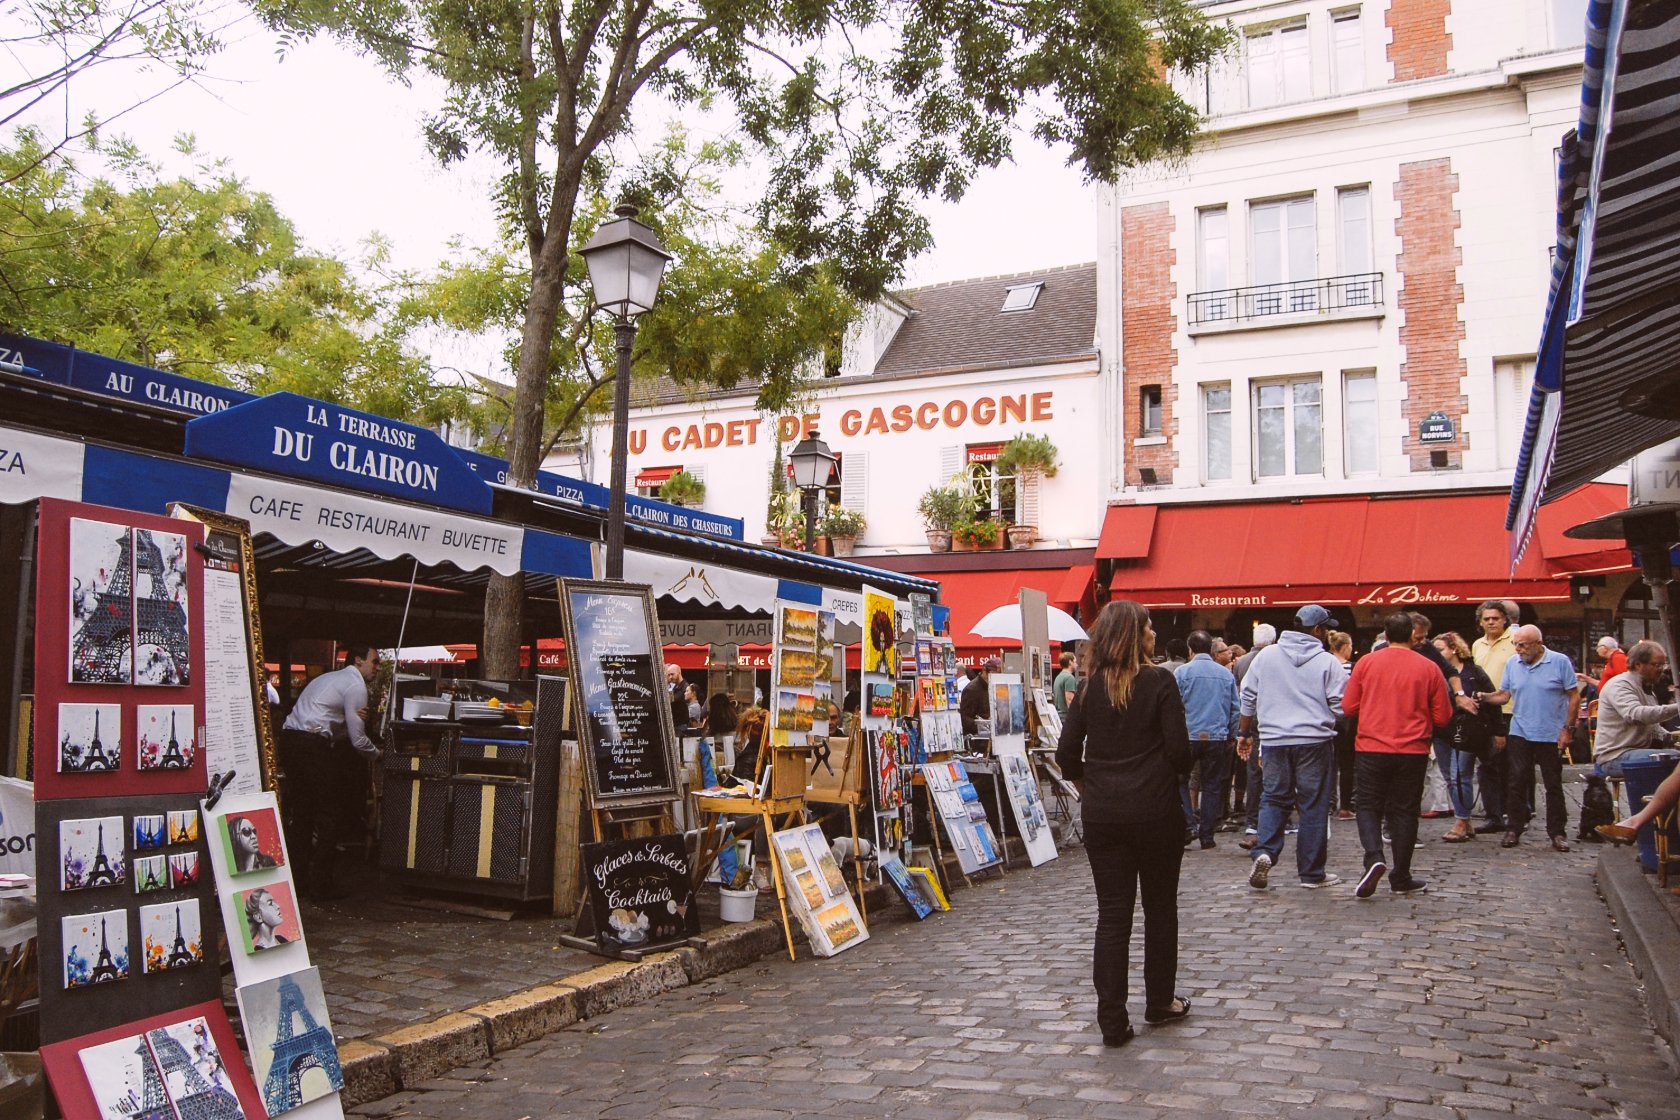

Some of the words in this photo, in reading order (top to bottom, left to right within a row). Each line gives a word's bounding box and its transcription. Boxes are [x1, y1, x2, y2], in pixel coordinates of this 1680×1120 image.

[106, 371, 133, 393] AU
[145, 381, 231, 413] CLAIRON
[307, 405, 328, 428] LA
[339, 413, 416, 450] TERRASSE
[662, 417, 761, 452] CADET
[778, 413, 820, 441] DE
[841, 391, 1054, 436] GASCOGNE
[272, 426, 314, 462] DU
[329, 441, 438, 492] CLAIRON
[556, 485, 584, 502] PIZZA
[249, 495, 303, 521] CAFE
[317, 508, 430, 542] RESTAURANT
[441, 529, 508, 554] BUVETTE
[632, 504, 669, 524] CLAIRON
[673, 514, 688, 528] DES
[691, 518, 732, 537] CHASSEURS
[832, 599, 858, 613] CREPES
[1191, 594, 1266, 606] Restaurant
[1357, 587, 1384, 605] La
[1387, 585, 1459, 604] Bohème
[540, 655, 559, 664] Café
[608, 677, 653, 697] Gastronomique
[593, 850, 633, 889] Glaces
[644, 843, 687, 875] Sorbets
[605, 886, 672, 909] Cocktails
